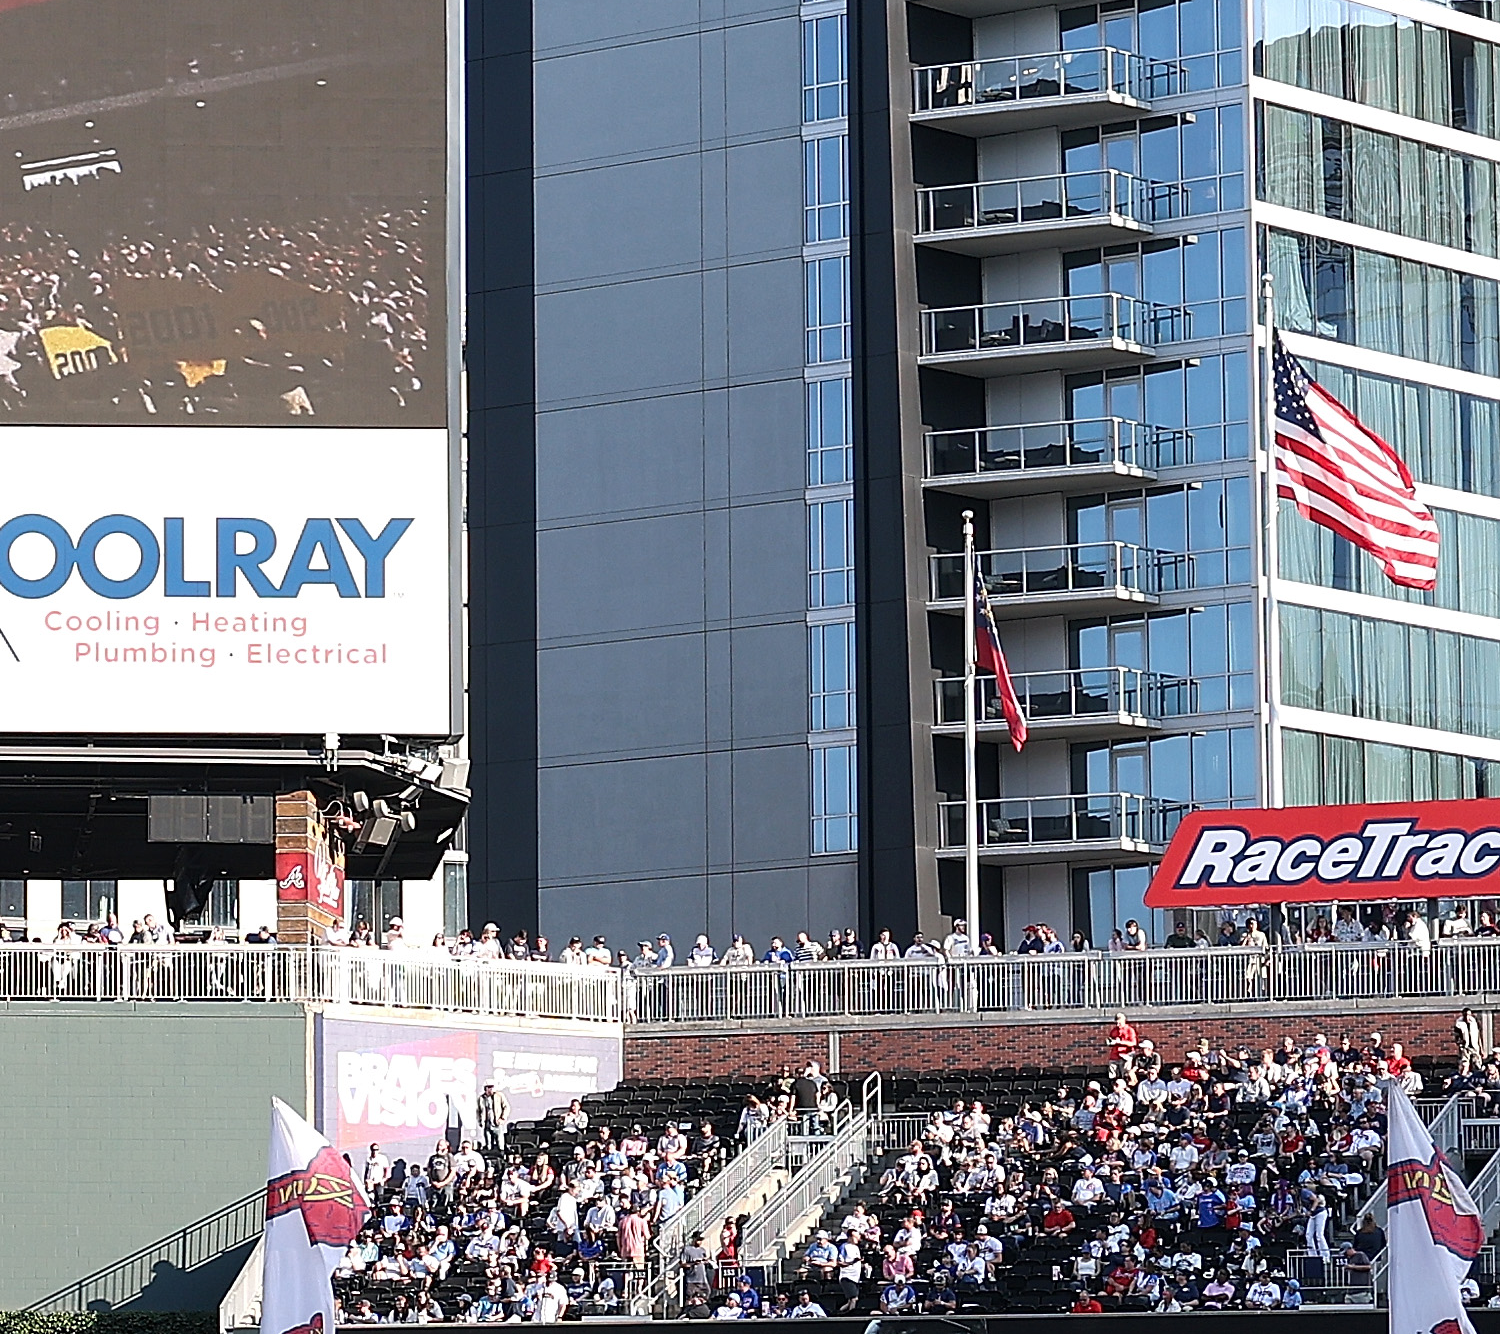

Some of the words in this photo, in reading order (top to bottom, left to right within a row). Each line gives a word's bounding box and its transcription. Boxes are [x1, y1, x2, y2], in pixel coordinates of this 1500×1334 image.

[44, 610, 161, 636] Cooling
[191, 611, 309, 637] Heating
[74, 642, 218, 669] Plumbing
[246, 643, 388, 665] Electrical
